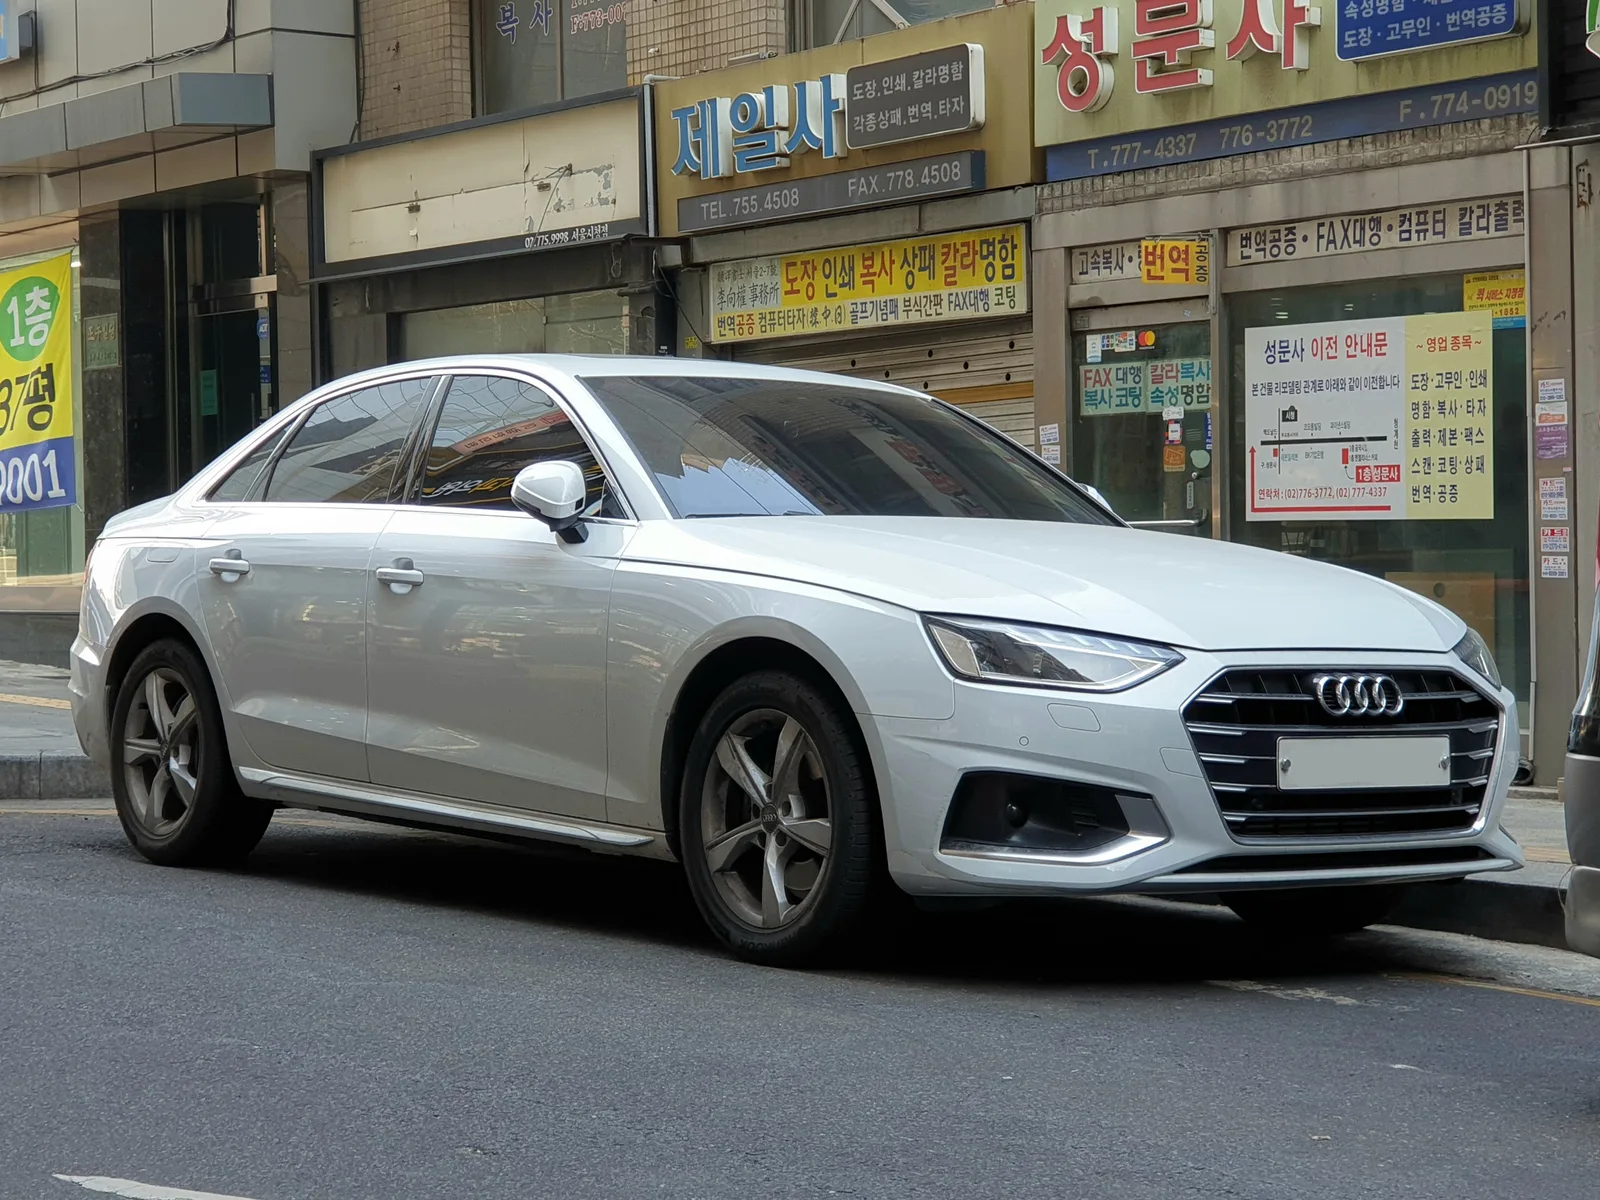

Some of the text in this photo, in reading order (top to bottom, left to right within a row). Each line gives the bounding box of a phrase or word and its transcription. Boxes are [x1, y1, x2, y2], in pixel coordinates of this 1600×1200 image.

[1343, 3, 1508, 49] 도장 고무인 번역공증
[1042, 0, 1319, 112] 성문사
[671, 73, 848, 180] 제일사
[1220, 114, 1313, 149] 776-3772
[571, 223, 609, 242] 서울시청점
[1240, 199, 1525, 261] 번역공증 FAX대행 컴퓨터 칼라출력
[784, 233, 1018, 301] 도장 인쇄 복사 상패 칼라명함
[1078, 246, 1125, 277] 고속복사
[1144, 243, 1190, 283] 번역
[7, 285, 52, 348] 1층
[850, 297, 899, 325] 골프기념패
[902, 293, 943, 319] 부식간판
[948, 287, 990, 313] FAX대행
[994, 284, 1016, 310] 코팅
[1264, 331, 1388, 365] 성문사 이전 안내문
[1426, 335, 1472, 353] 영업 종목
[1083, 365, 1142, 388] FAX 대행
[1251, 374, 1400, 396] 본 건물 리모델링 관계로 아래와 같이 이전합니다
[1084, 386, 1142, 410] 복사 코팅
[1150, 383, 1211, 406] 속성명함
[1358, 466, 1398, 482] 1층 성문사
